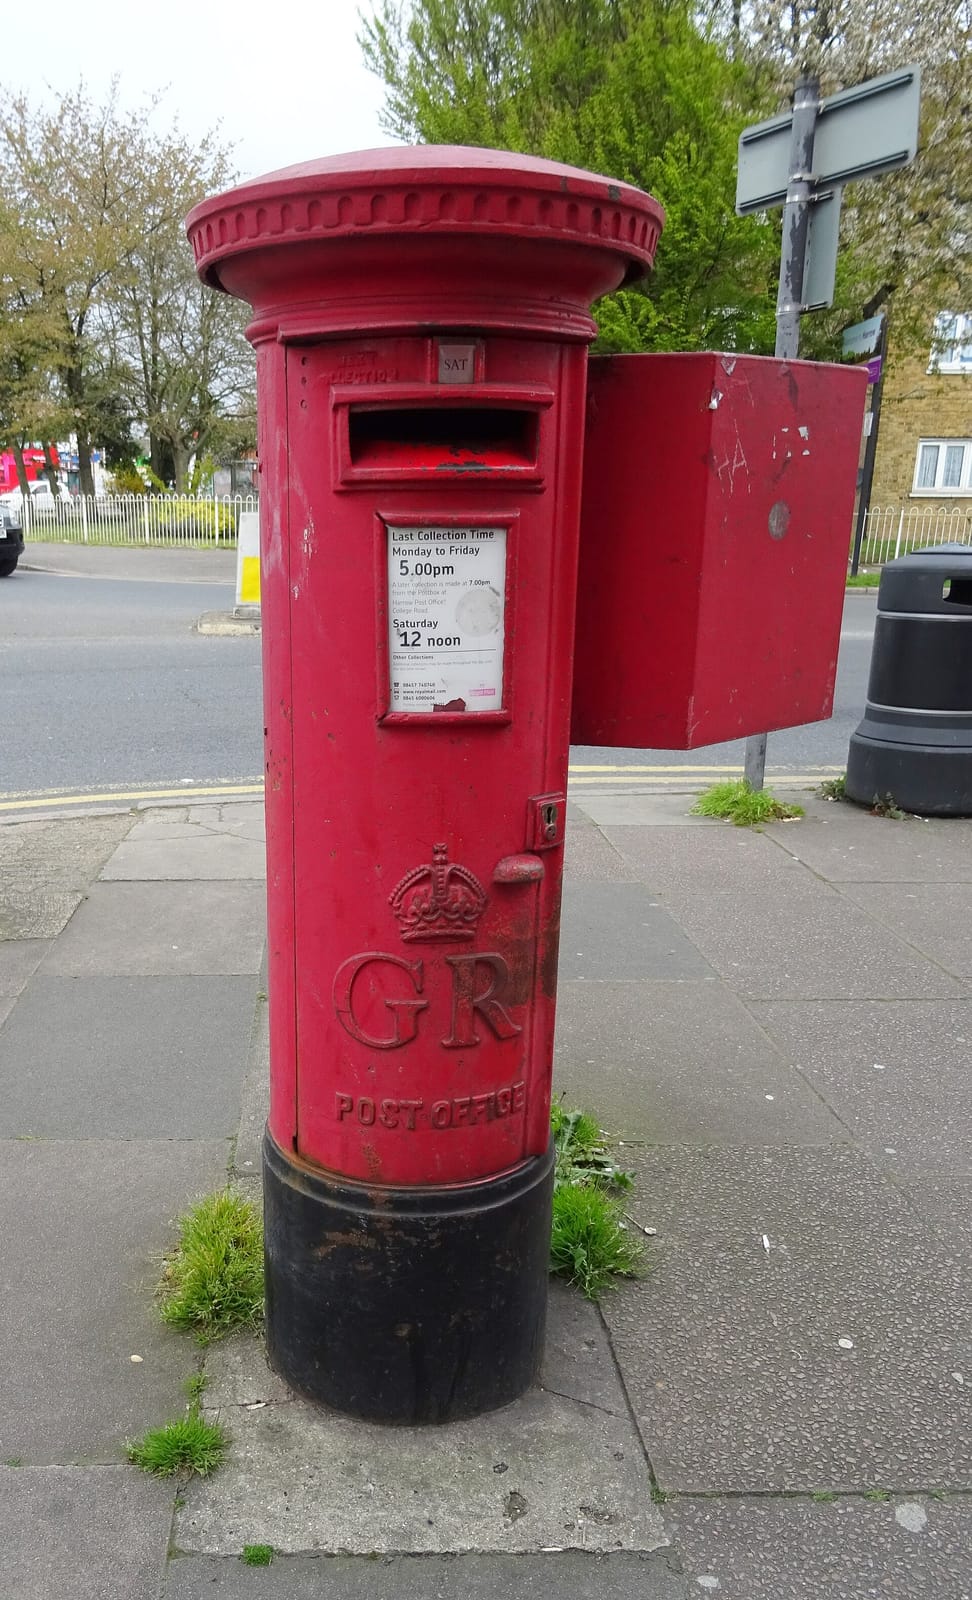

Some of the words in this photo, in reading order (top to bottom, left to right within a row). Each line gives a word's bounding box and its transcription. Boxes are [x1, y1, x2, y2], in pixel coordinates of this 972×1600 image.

[444, 359, 468, 371] SAT
[392, 531, 415, 542] Last
[418, 530, 467, 541] Collection
[469, 529, 495, 540] Time
[392, 546, 432, 558] Monday
[435, 547, 446, 556] to
[449, 545, 480, 557] Friday
[399, 559, 455, 578] 5.00pm
[468, 579, 491, 587] 7.00pm
[392, 618, 439, 629] Saturday
[399, 630, 422, 647] 12
[427, 636, 461, 647] noon
[335, 1091, 424, 1130] POST
[430, 1080, 526, 1130] OFFICE
